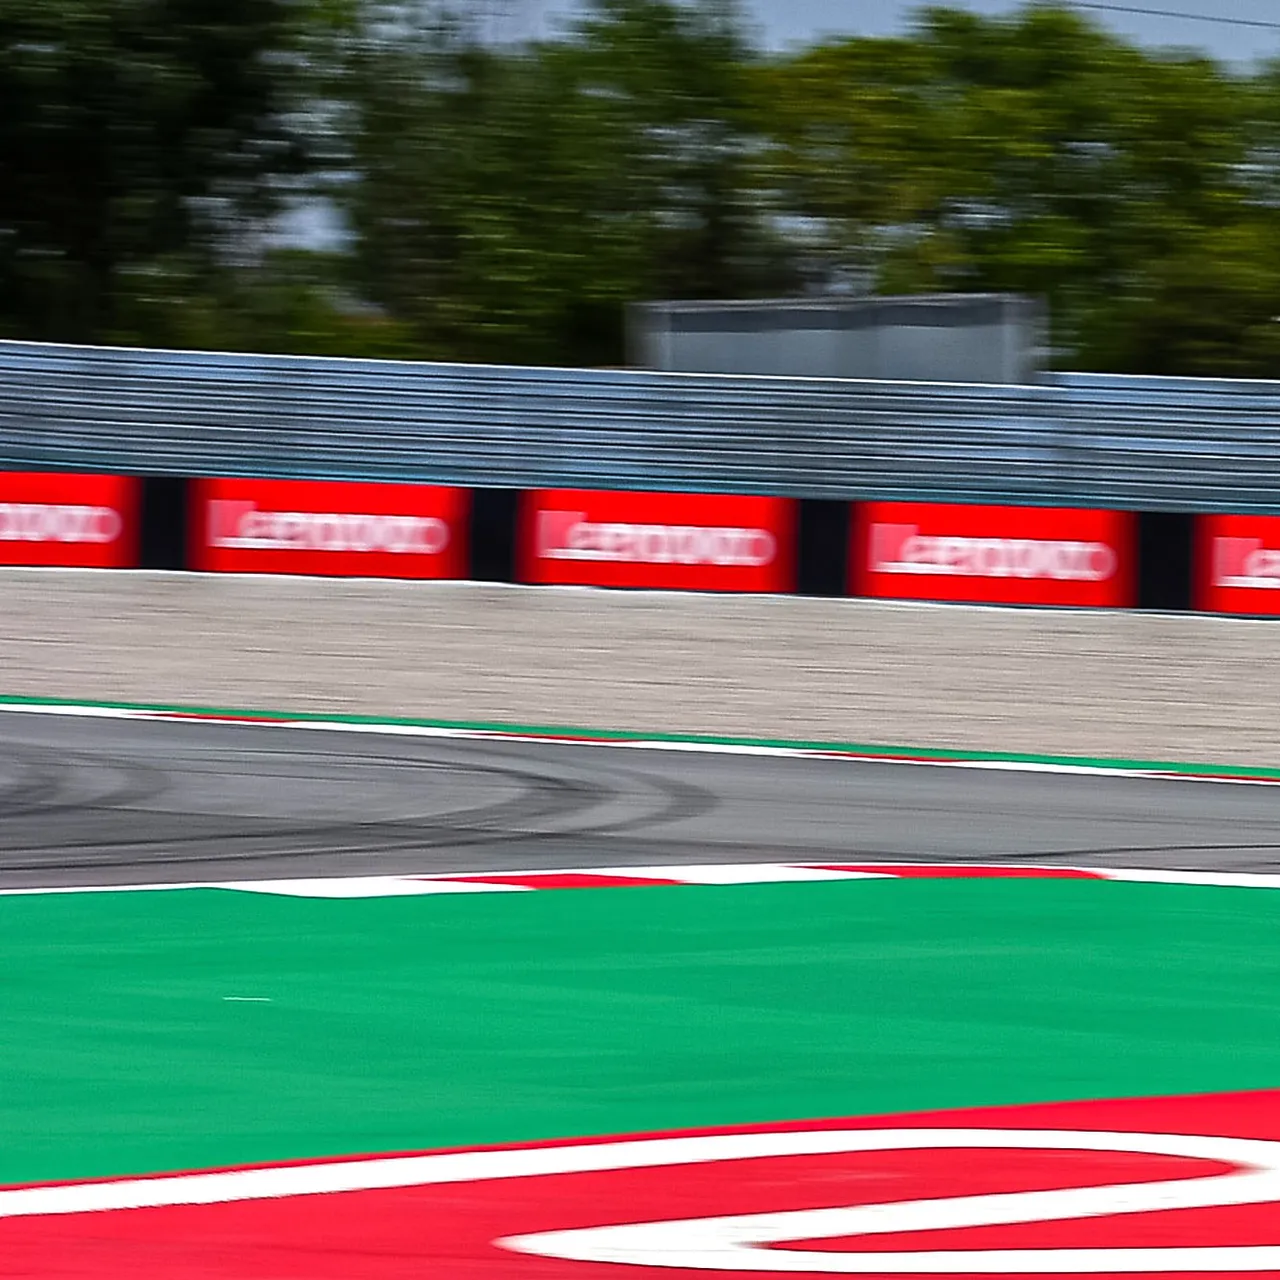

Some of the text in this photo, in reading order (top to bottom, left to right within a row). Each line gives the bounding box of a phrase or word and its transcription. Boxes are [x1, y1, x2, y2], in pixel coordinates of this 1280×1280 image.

[210, 500, 448, 554] Lenovo
[537, 510, 776, 567] Lenovo
[870, 523, 1115, 581] Lenovo
